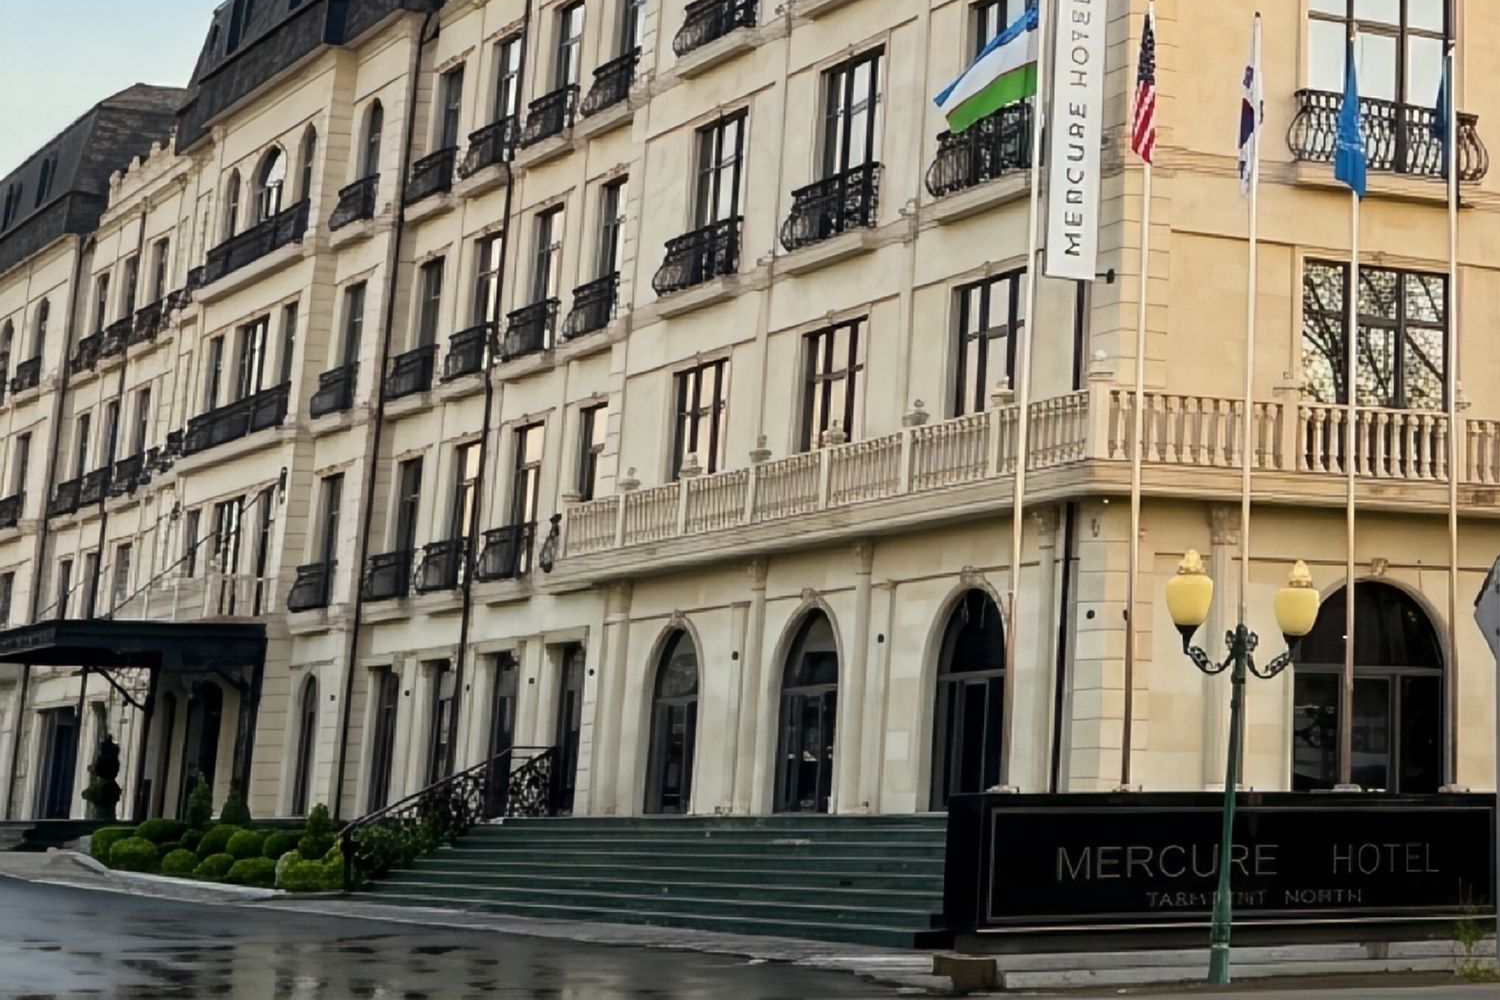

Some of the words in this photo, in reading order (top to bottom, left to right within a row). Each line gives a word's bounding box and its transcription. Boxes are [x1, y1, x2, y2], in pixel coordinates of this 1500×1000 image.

[1056, 843, 1279, 881] MERCURE
[1332, 842, 1440, 875] HOTEL
[1284, 887, 1362, 905] NORTH
